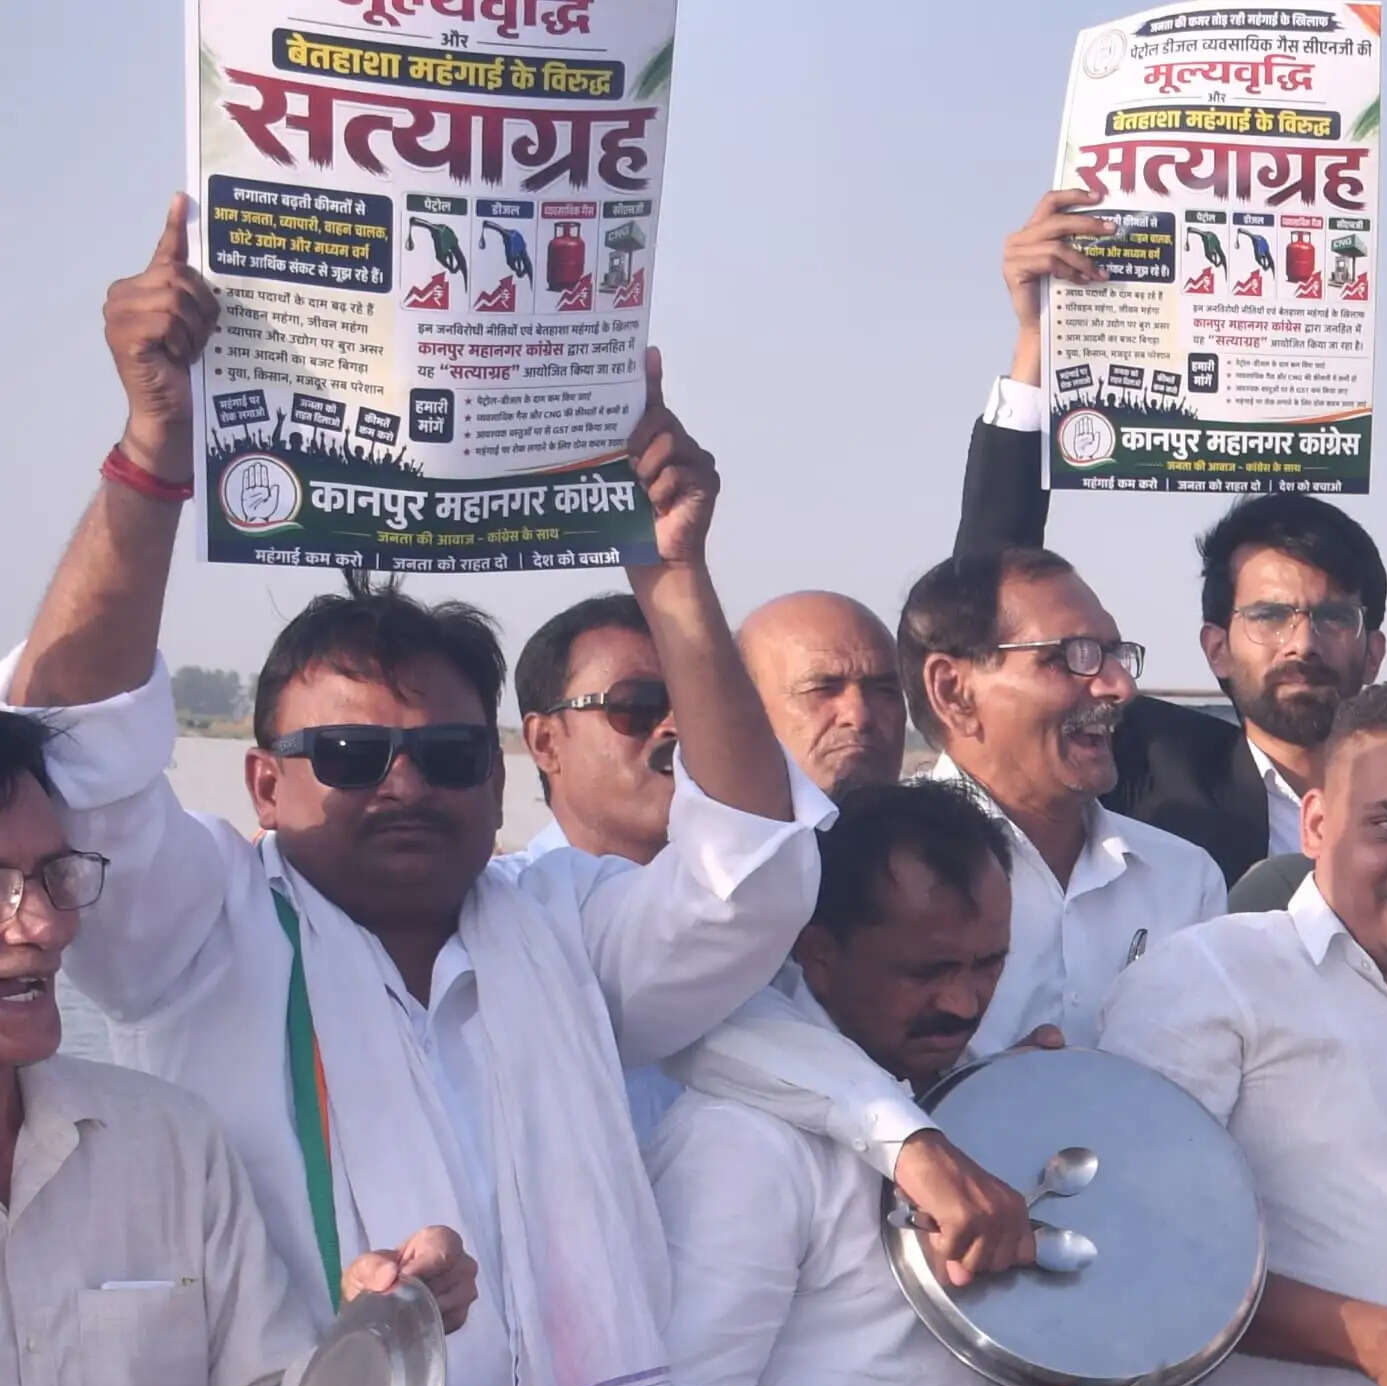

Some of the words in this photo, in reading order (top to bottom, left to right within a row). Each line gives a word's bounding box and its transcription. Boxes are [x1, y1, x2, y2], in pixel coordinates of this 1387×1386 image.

[441, 30, 469, 48] और
[1130, 40, 1158, 60] पेट्रोल
[1161, 37, 1198, 57] डीजल
[1202, 37, 1273, 54] व्यवसायिक
[1275, 36, 1299, 54] गैस
[1303, 39, 1354, 57] सीएनजी
[1356, 41, 1372, 57] की
[285, 33, 402, 80] बेतहाशा
[407, 52, 504, 88] महंगाई
[507, 62, 536, 90] के
[541, 67, 612, 96] विरुद्ध
[1143, 54, 1315, 94] मूल्यवृद्धि
[1207, 91, 1227, 103] और
[222, 67, 658, 191] सत्याग्रह
[1109, 108, 1182, 130] बेतहाशा
[1185, 107, 1251, 132] महंगाई
[1254, 109, 1274, 131] के
[1277, 110, 1332, 137] विरुद्ध
[1076, 140, 1369, 211] सत्याग्रह
[233, 188, 279, 205] लगातार
[314, 195, 353, 214] कीमतों
[355, 200, 366, 216] से
[418, 342, 465, 361] कानपुर
[468, 344, 523, 358] महानगर
[525, 340, 564, 356] कांग्रेस
[591, 338, 626, 353] जनहित
[415, 398, 448, 414] हमारी
[1120, 427, 1202, 460] कानपुर
[1206, 430, 1295, 456] महानगर
[1298, 426, 1361, 455] कांग्रेस
[309, 480, 428, 530] कानपुर
[435, 486, 548, 523] महानगर
[553, 473, 635, 513] कांग्रेस
[252, 547, 304, 567] महंगाई
[305, 552, 331, 565] कम
[335, 551, 363, 567] करो
[393, 558, 433, 571] जनता
[437, 556, 456, 570] को
[460, 558, 488, 572] राहत
[487, 553, 508, 570] दो
[532, 551, 554, 568] देश
[557, 550, 575, 566] को
[578, 547, 620, 565] बचाओ
